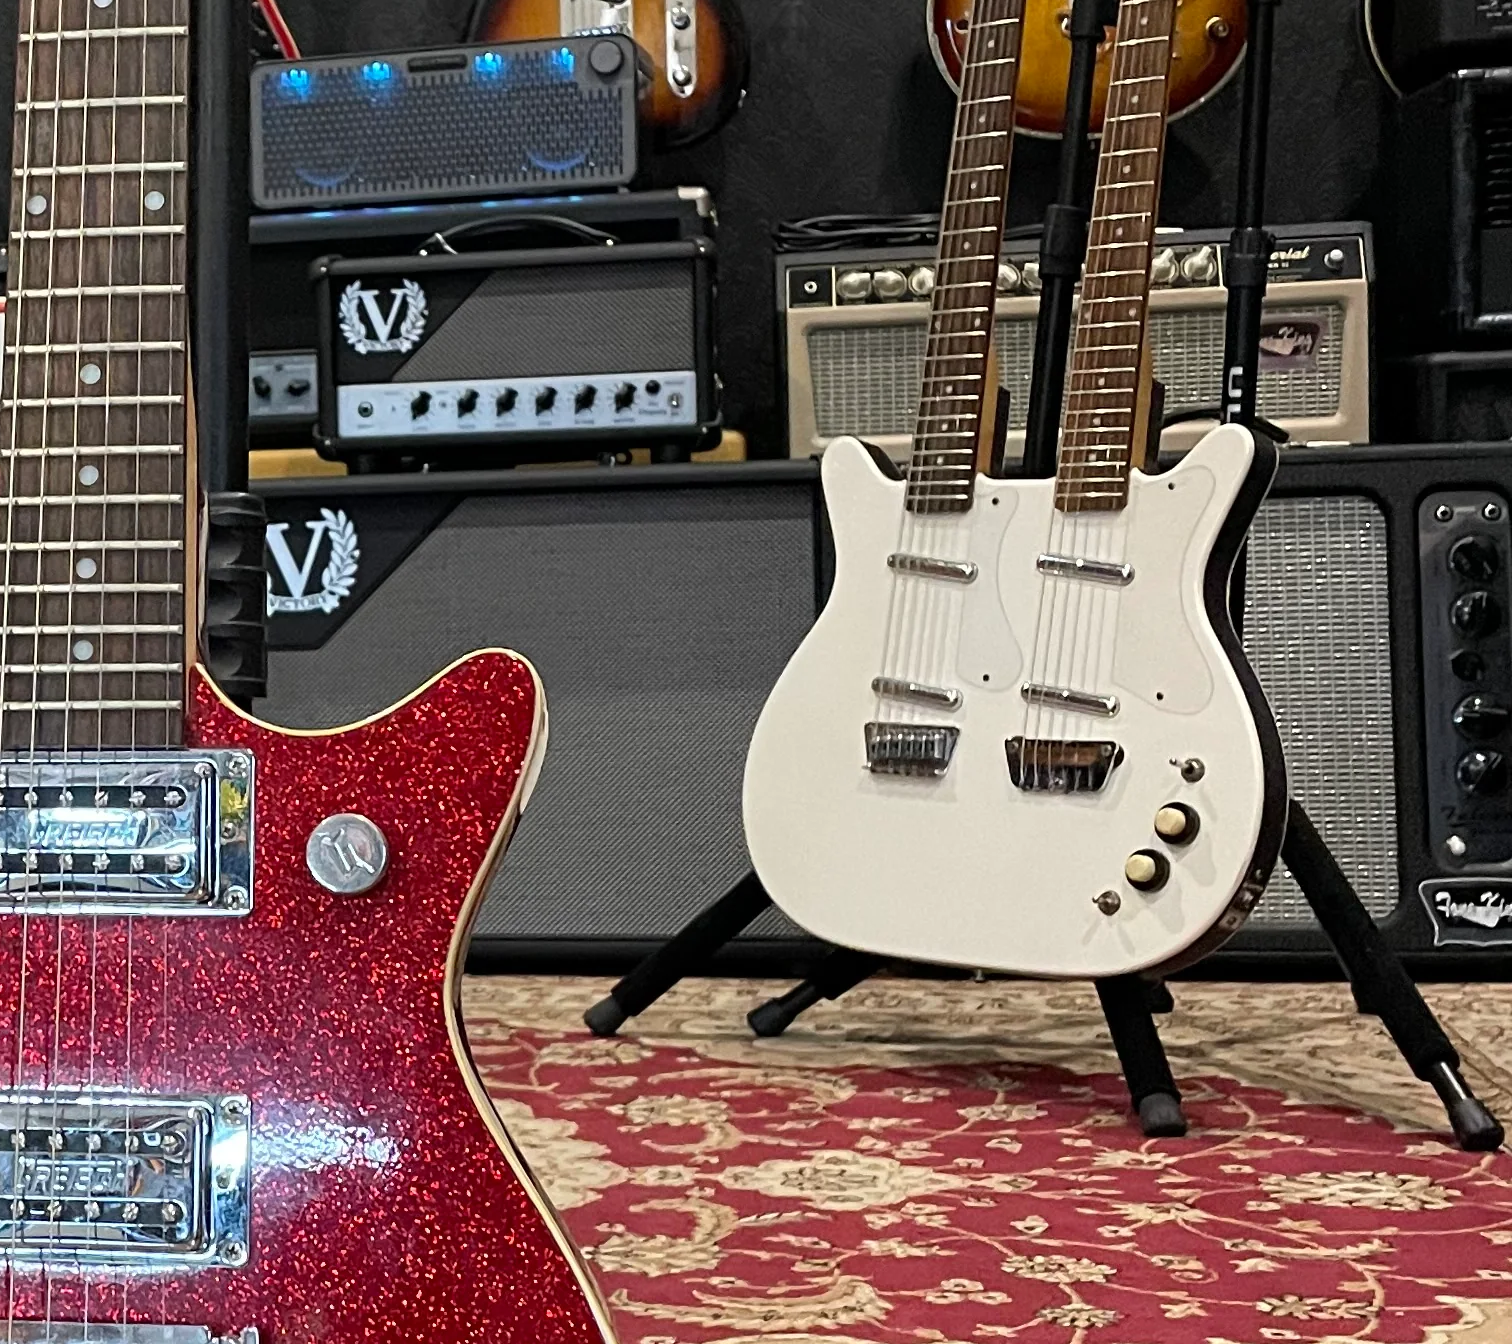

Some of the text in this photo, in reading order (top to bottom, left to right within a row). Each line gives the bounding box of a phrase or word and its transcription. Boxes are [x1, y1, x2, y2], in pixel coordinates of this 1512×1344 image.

[356, 288, 409, 344] V
[266, 521, 327, 598] V
[269, 593, 328, 610] VICTORY
